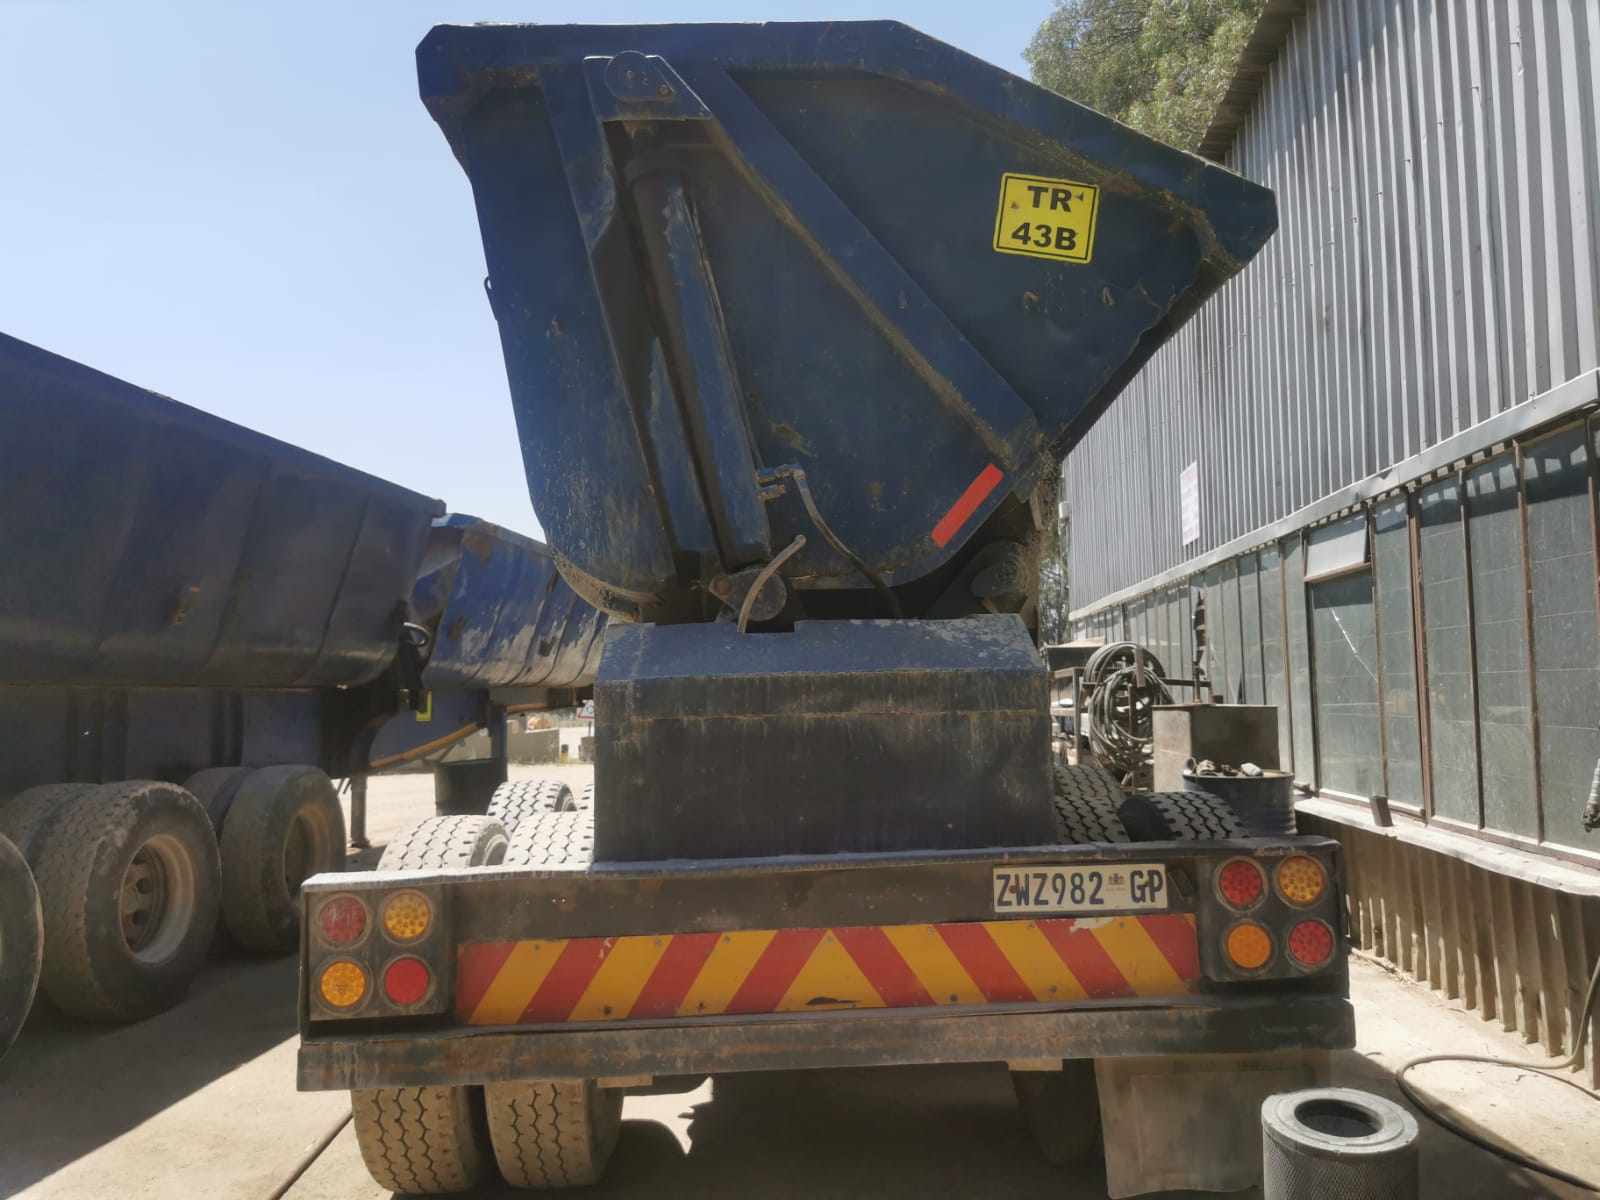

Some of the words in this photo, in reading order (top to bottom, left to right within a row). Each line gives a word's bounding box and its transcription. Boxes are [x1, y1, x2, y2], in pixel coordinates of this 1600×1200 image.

[1027, 185, 1072, 212] TR
[1011, 222, 1077, 250] 43B
[995, 871, 1104, 906] ZWZ982
[1130, 869, 1164, 903] GP
